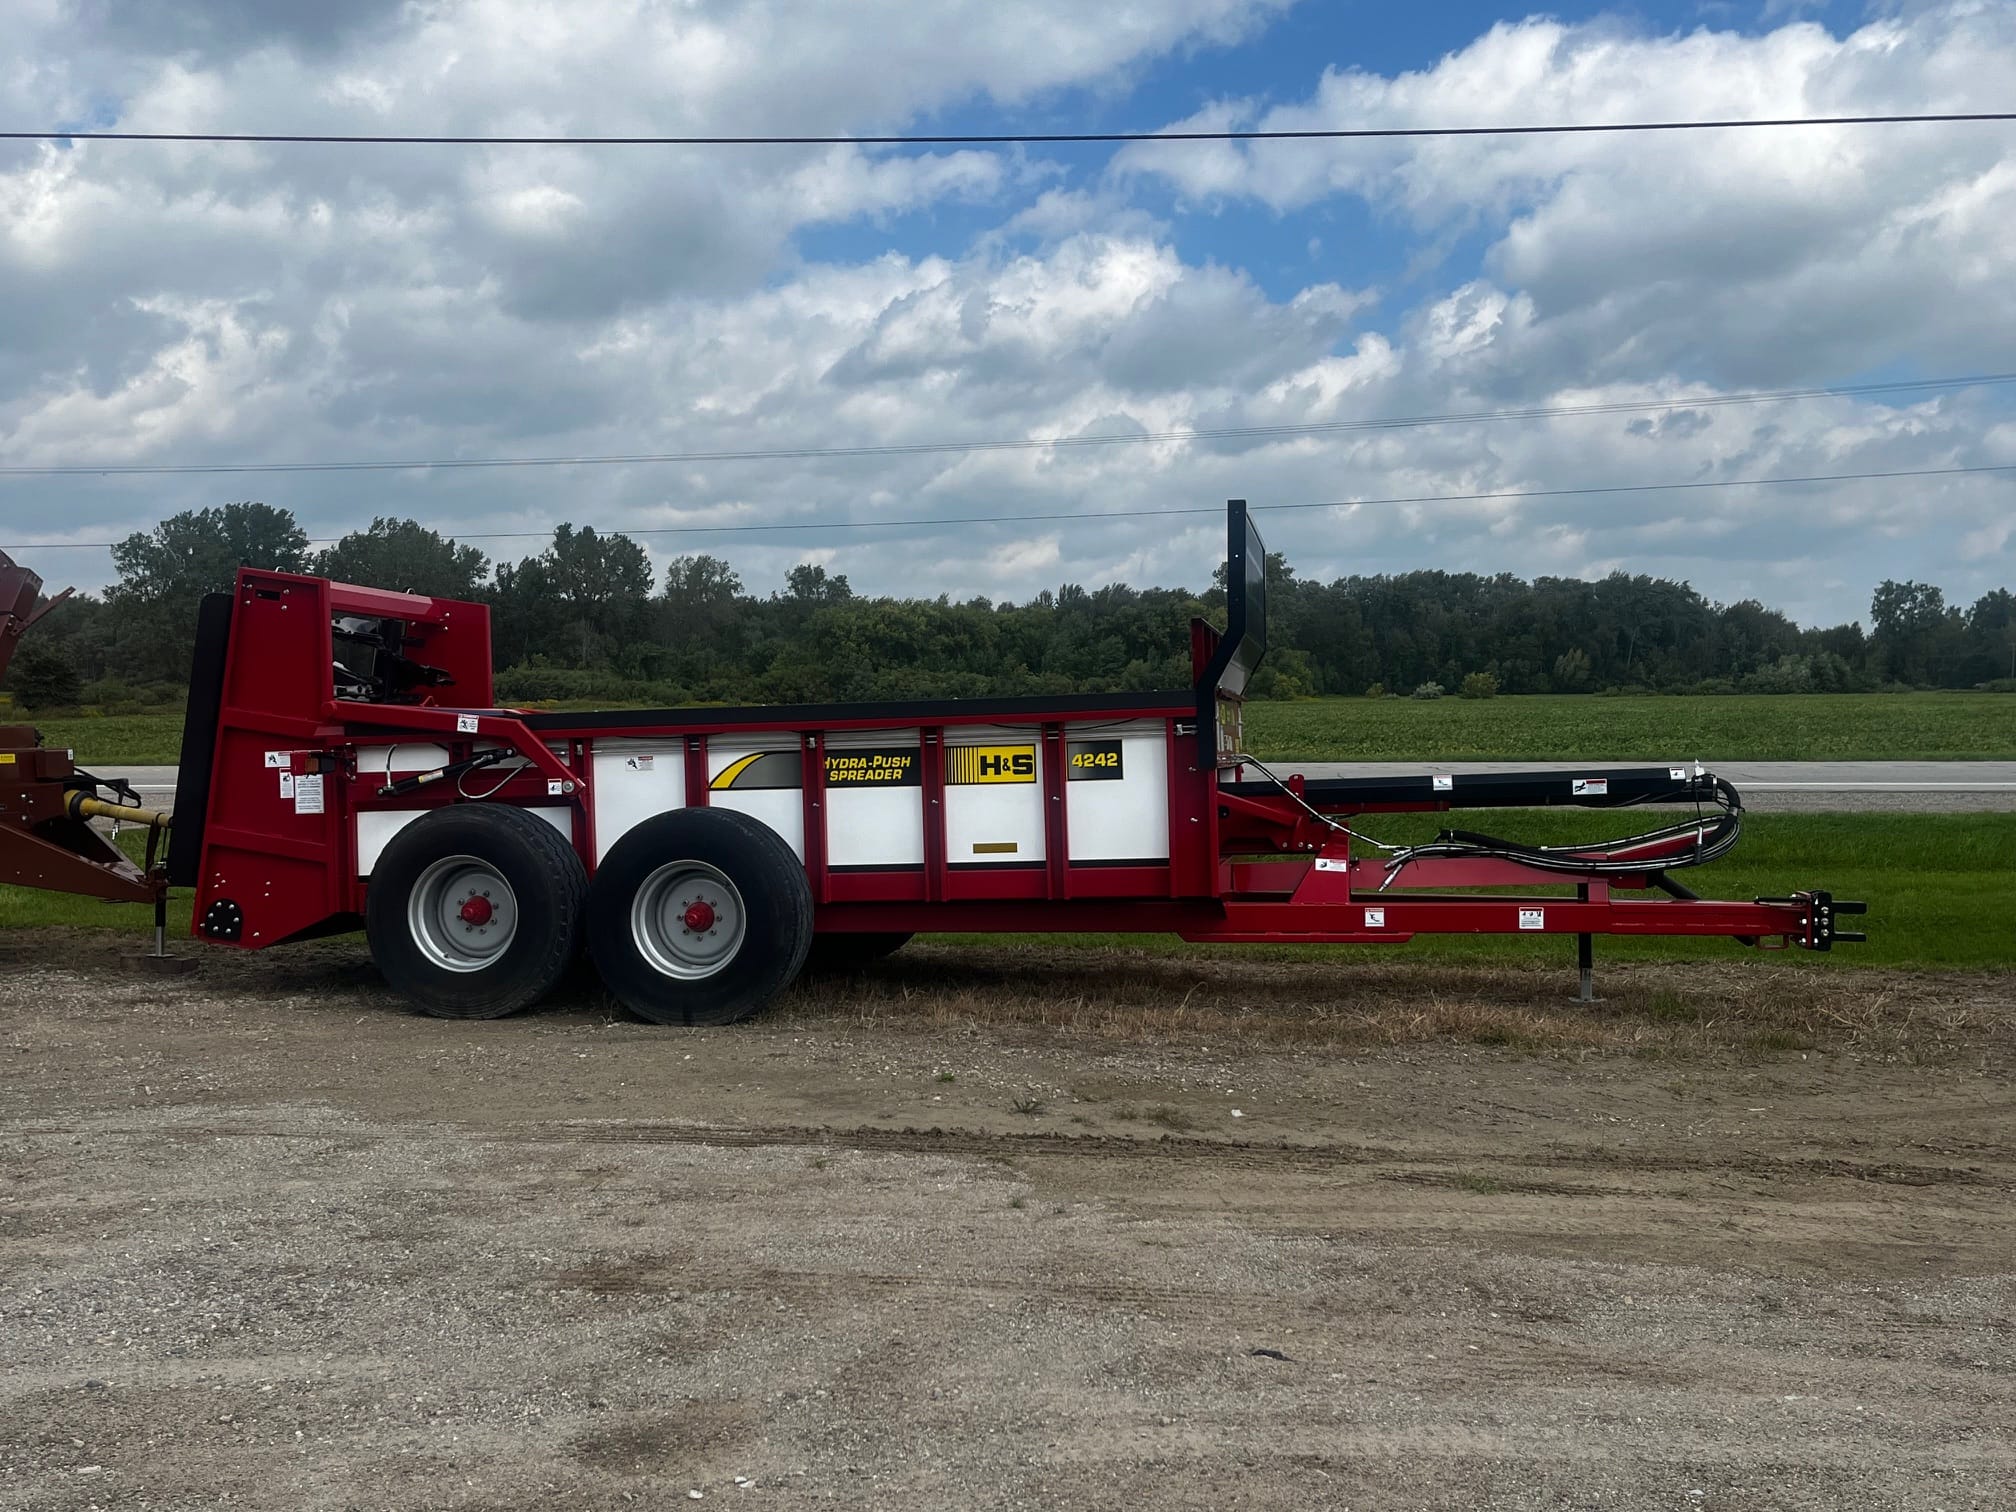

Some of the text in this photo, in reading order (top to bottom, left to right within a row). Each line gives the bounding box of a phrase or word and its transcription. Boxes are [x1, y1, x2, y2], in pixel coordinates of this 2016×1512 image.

[980, 754, 1034, 776] H&S
[1072, 753, 1118, 768] 4242
[829, 769, 902, 781] SPREADER
